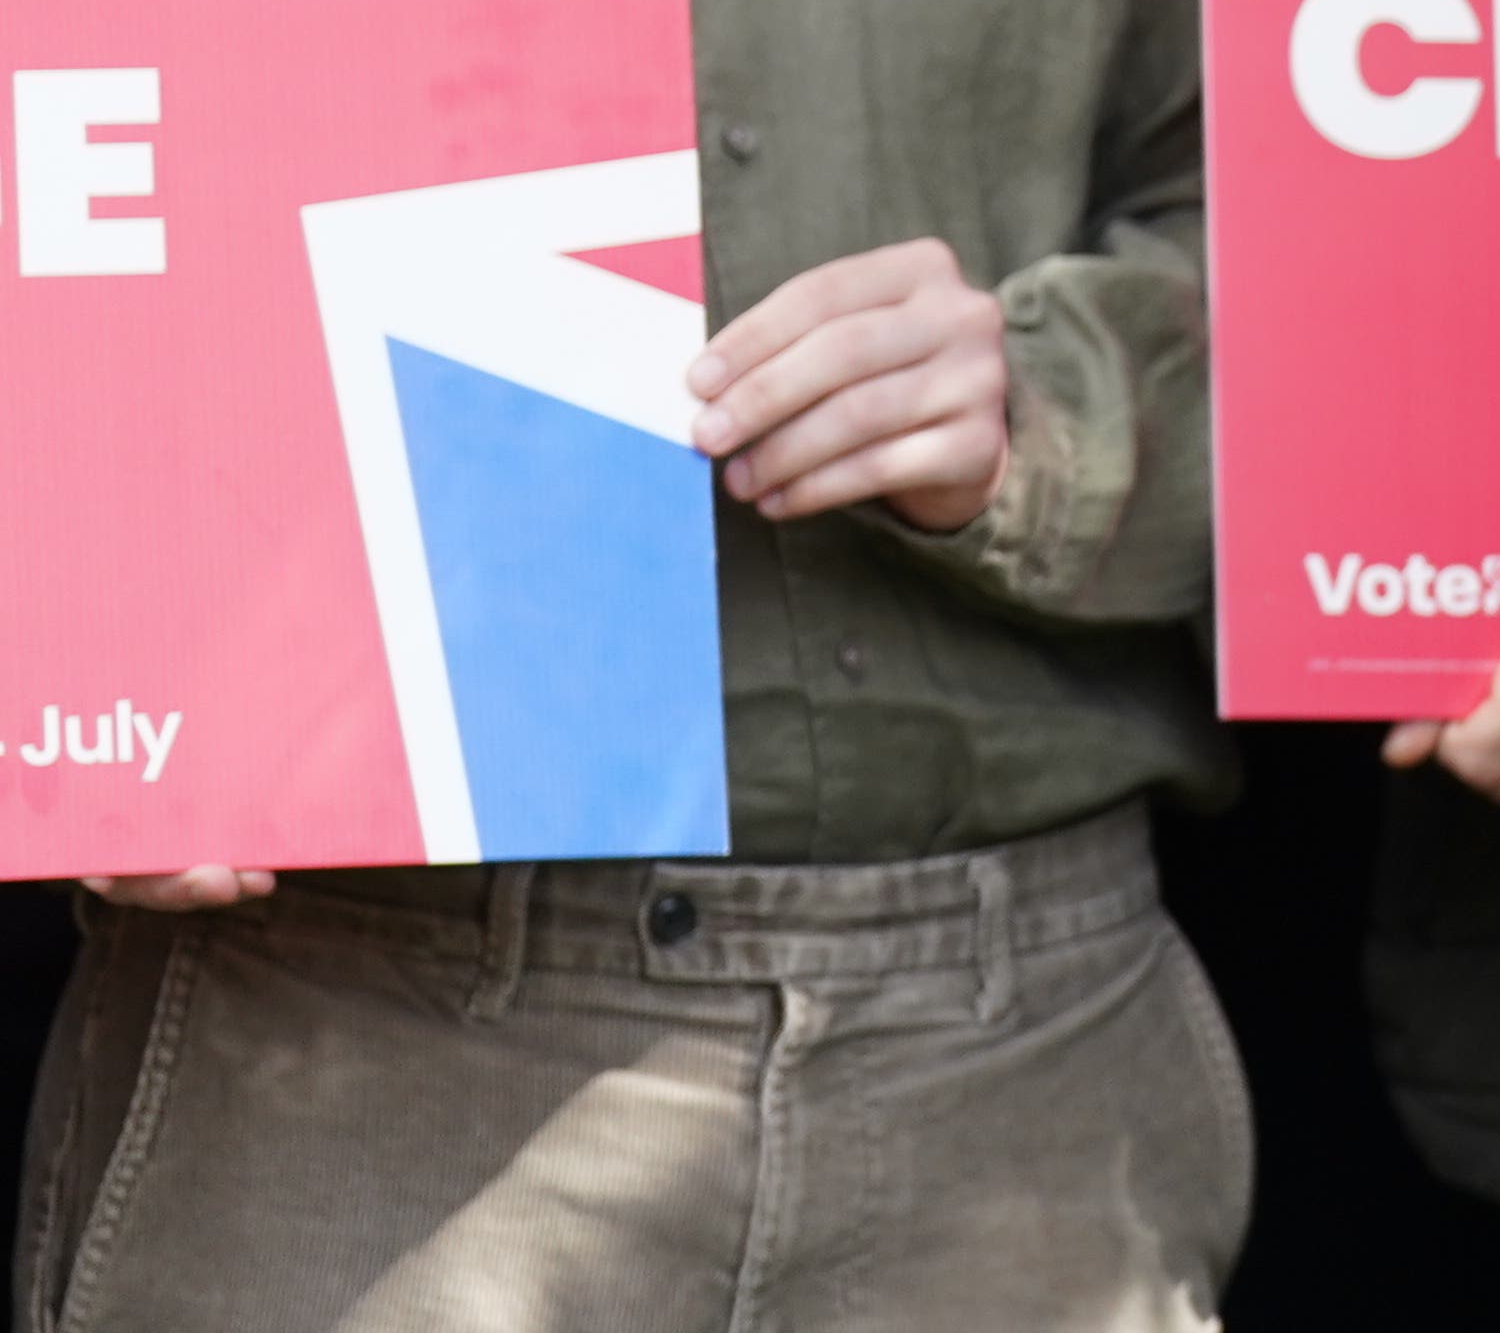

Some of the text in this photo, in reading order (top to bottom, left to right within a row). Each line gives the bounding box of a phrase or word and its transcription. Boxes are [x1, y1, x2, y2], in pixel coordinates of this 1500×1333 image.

[11, 65, 168, 278] E
[1302, 551, 1482, 617] Vote
[19, 697, 184, 783] July
